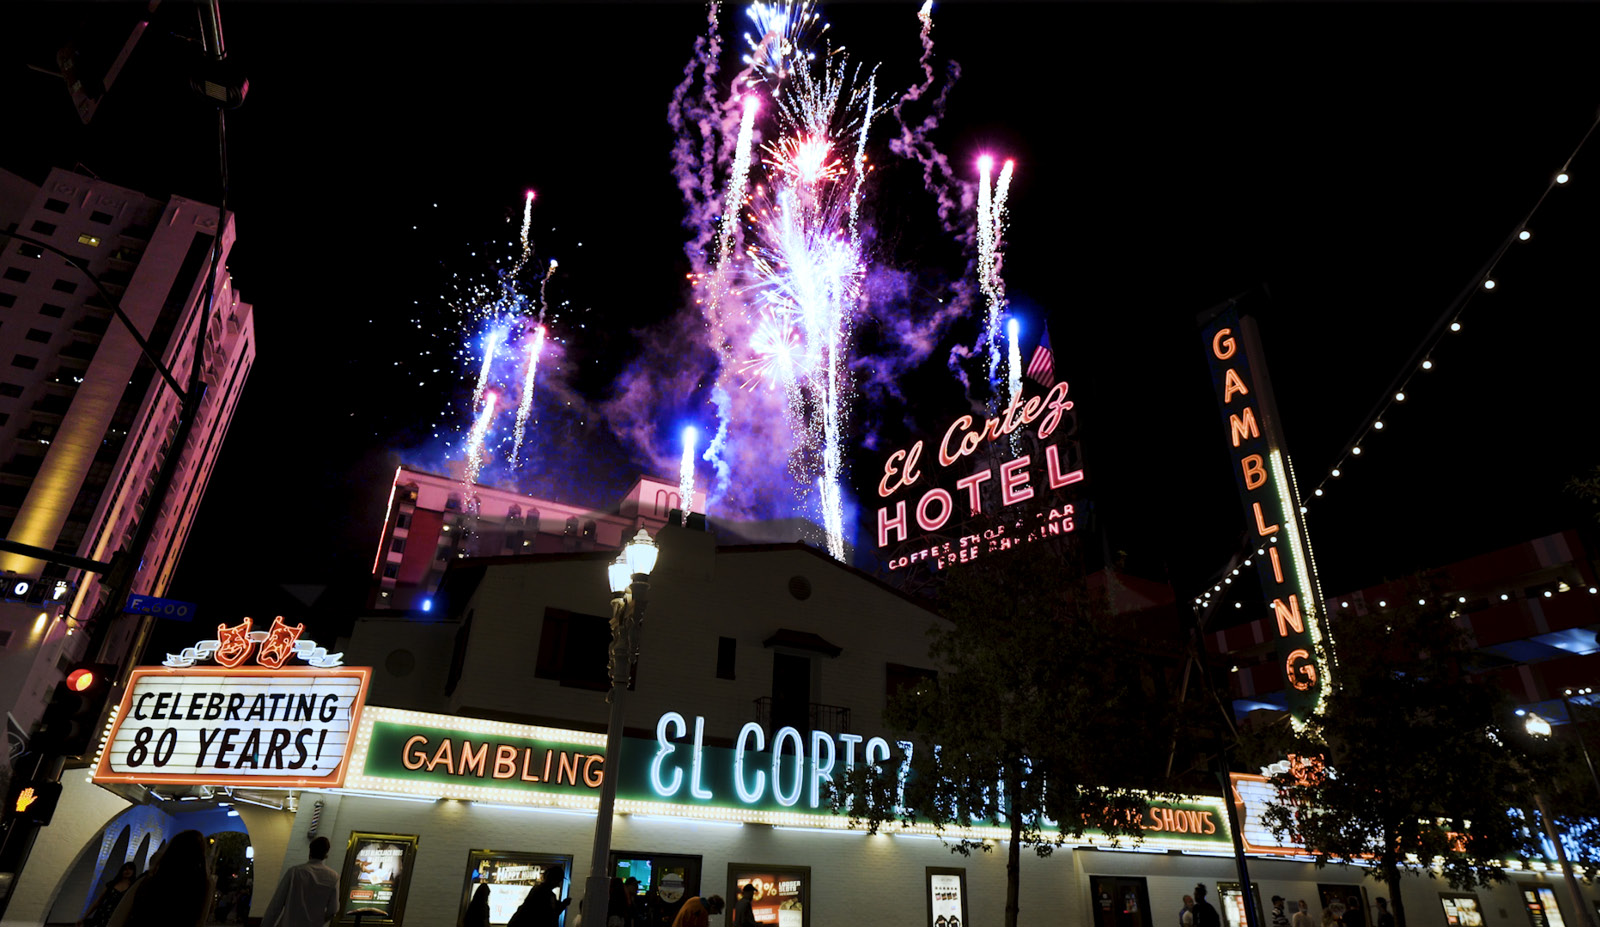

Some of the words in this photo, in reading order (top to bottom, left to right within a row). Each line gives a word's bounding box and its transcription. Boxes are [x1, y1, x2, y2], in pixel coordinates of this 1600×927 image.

[878, 440, 923, 498] El
[937, 381, 1074, 468] Cortez
[877, 443, 1084, 548] HOTEL
[1036, 504, 1075, 522] AR
[1212, 327, 1318, 693] GAMBLING
[937, 546, 979, 570] FREE
[152, 602, 188, 617] 600
[133, 691, 339, 724] CELEBRATING
[126, 727, 178, 768] 80
[195, 727, 329, 771] YEARS!
[401, 733, 605, 789] GAMBLING
[651, 711, 713, 800] EL
[1149, 806, 1216, 835] SHOWS
